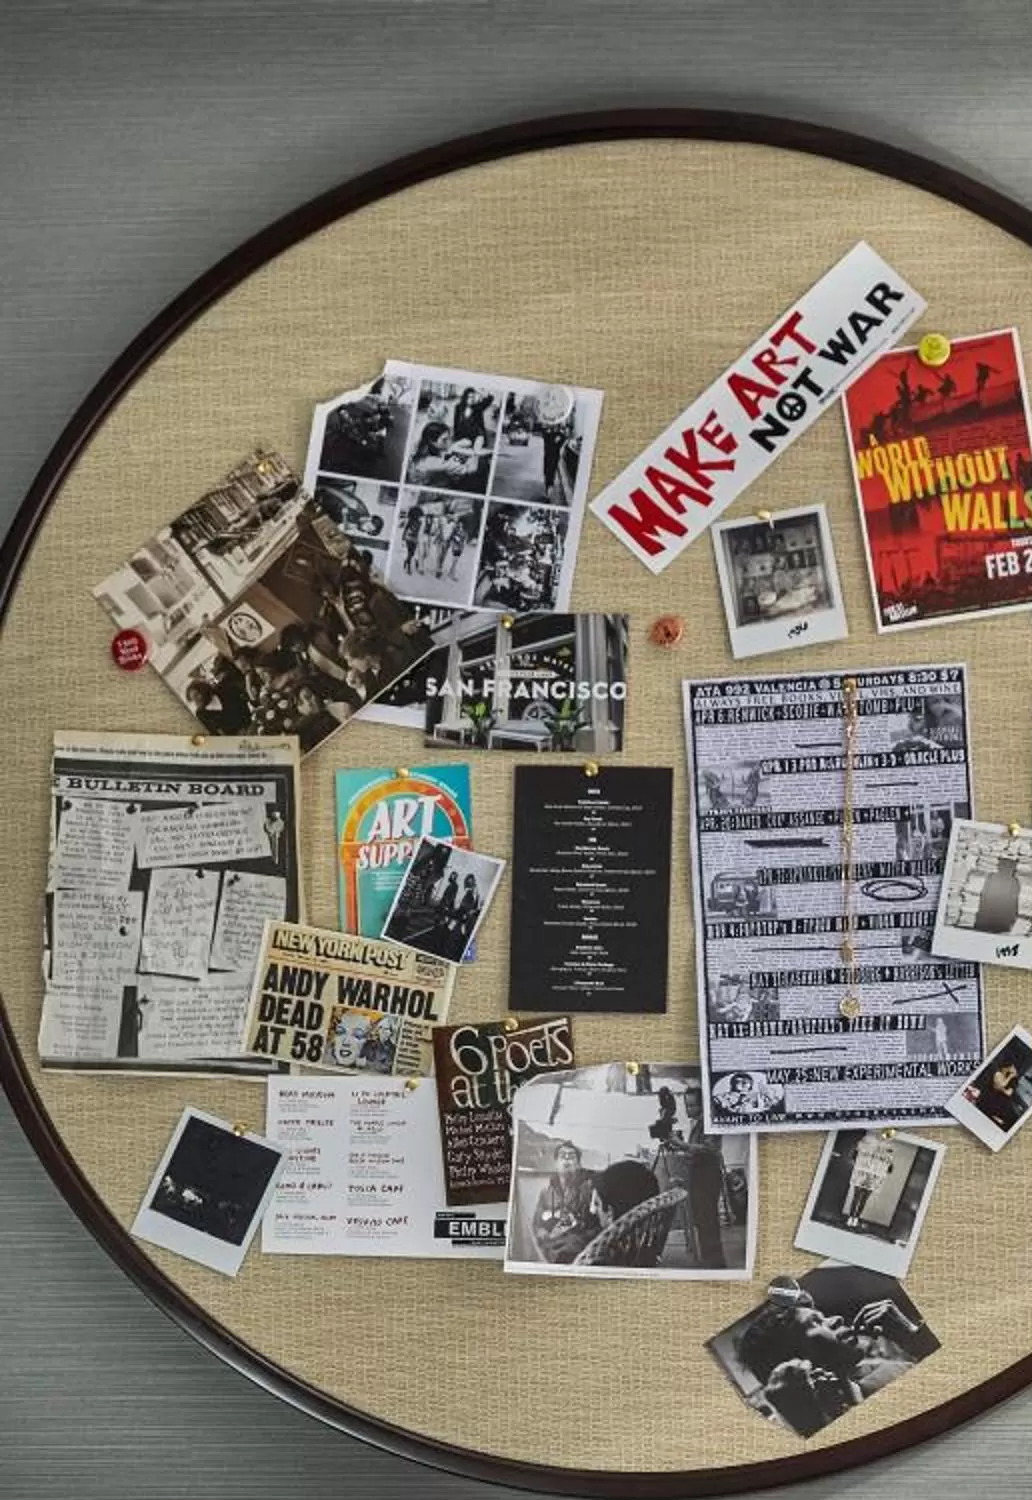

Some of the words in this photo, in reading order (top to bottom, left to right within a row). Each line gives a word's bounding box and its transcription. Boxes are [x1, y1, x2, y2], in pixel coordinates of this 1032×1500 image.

[749, 366, 824, 453] NOT
[818, 281, 905, 366] WAR
[608, 411, 740, 556] MAKE
[726, 311, 817, 424] ART
[856, 436, 932, 481] WORLD
[882, 446, 1013, 505] WITHOUT
[985, 551, 1021, 580] FEB
[425, 678, 475, 698] SAN
[483, 678, 627, 701] FRANCISCO
[67, 777, 182, 796] BULLETIN
[187, 782, 266, 798] BOARD
[367, 794, 443, 844] ART
[273, 929, 317, 955] NEW
[315, 936, 365, 963] YORK
[363, 945, 410, 971] POST
[257, 993, 326, 1031] DEAD
[262, 963, 331, 1001] ANDY
[337, 975, 439, 1021] WARHOL
[251, 1024, 286, 1056] AT
[290, 1031, 325, 1063] 58
[449, 1025, 488, 1076] 6
[451, 1073, 491, 1110] at
